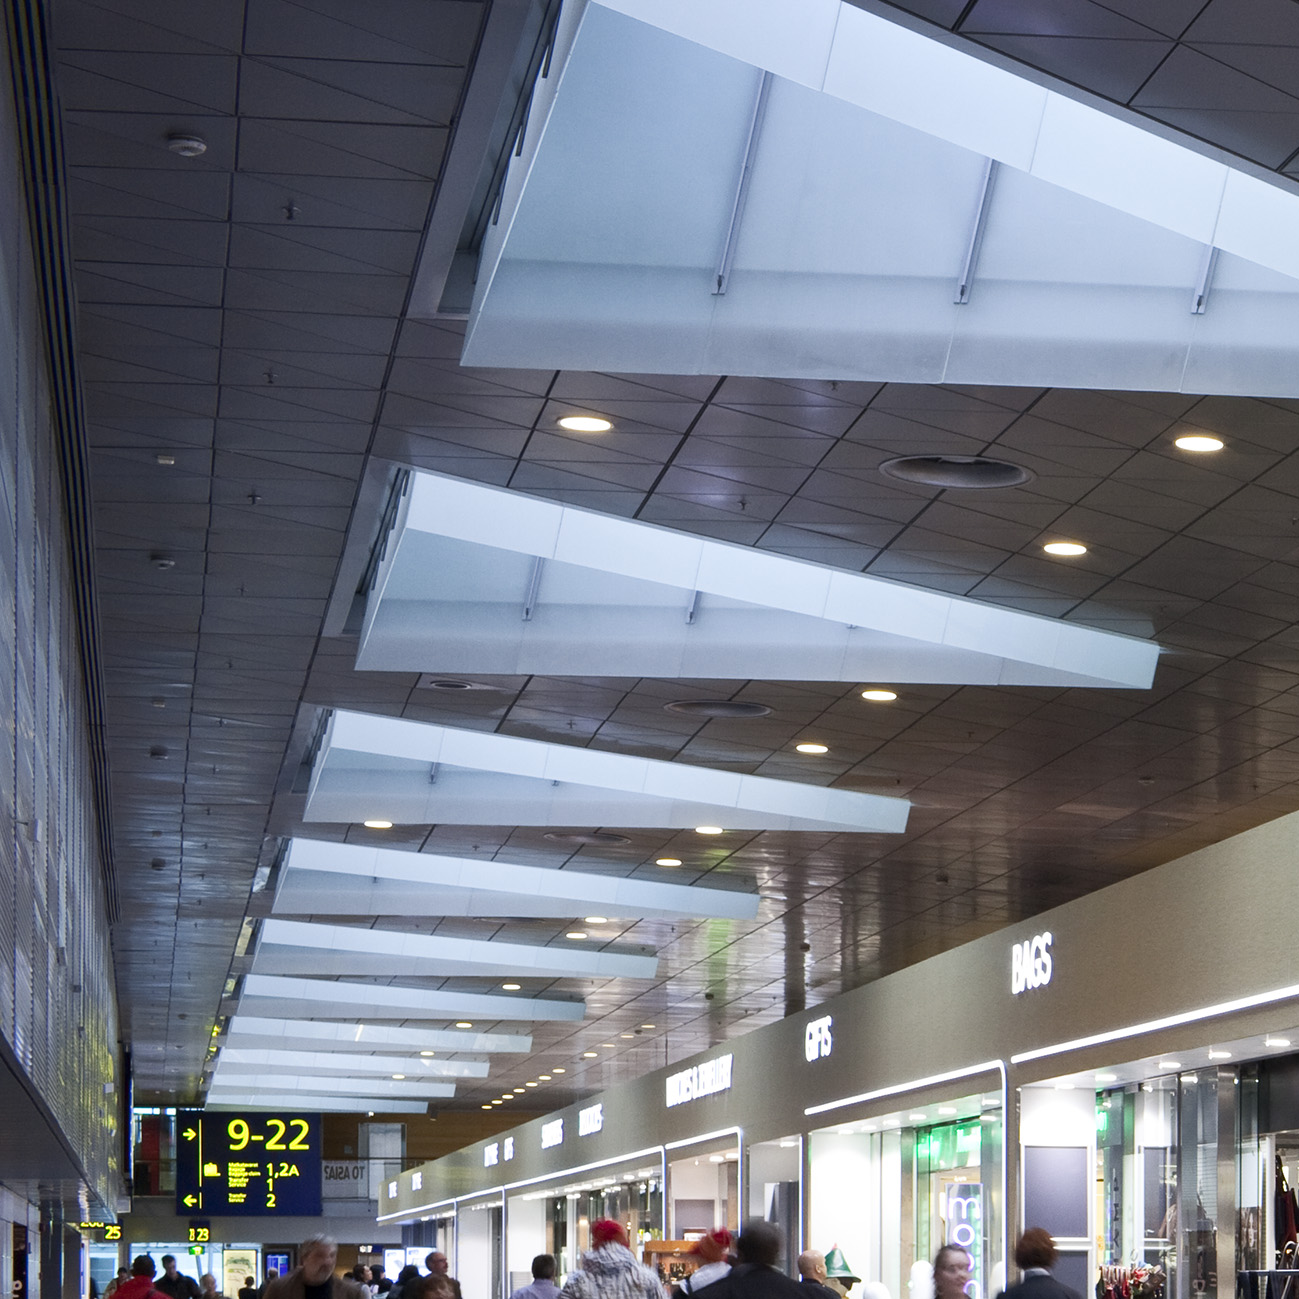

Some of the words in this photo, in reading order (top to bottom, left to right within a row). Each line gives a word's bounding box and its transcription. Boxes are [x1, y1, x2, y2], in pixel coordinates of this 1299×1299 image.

[1012, 932, 1053, 995] BAGS
[805, 1015, 833, 1062] GIFTS
[227, 1119, 310, 1150] 9-22
[266, 1162, 299, 1179] 1,2A
[266, 1178, 274, 1192] 1
[266, 1194, 276, 1208] 2
[104, 1225, 121, 1240] 25
[197, 1228, 210, 1241] 23
